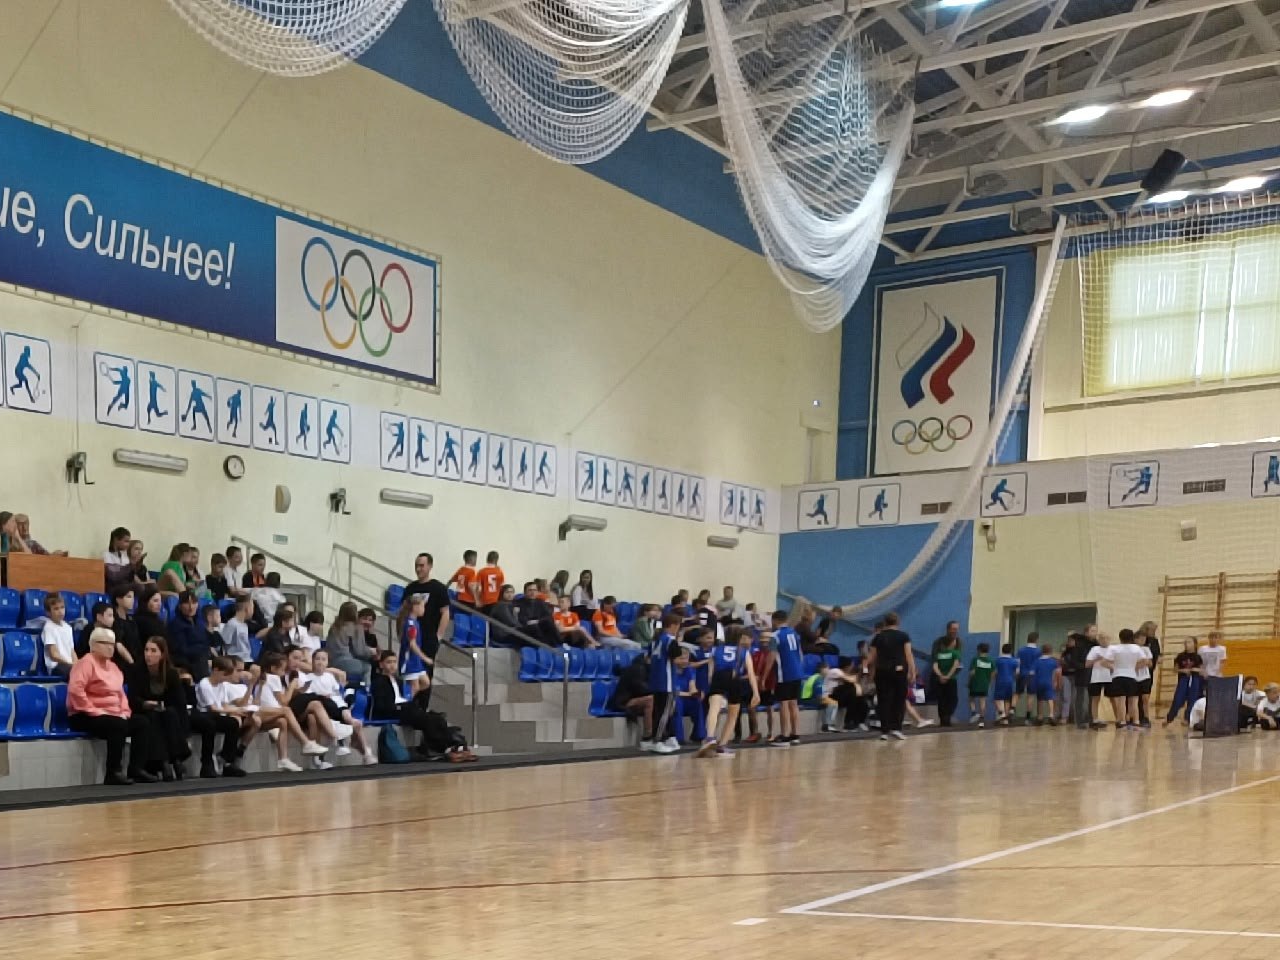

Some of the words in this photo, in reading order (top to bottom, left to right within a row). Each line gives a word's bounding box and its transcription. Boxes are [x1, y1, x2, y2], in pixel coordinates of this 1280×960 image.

[64, 193, 235, 290] Сильнее!
[487, 574, 498, 592] 5
[723, 645, 737, 662] 5
